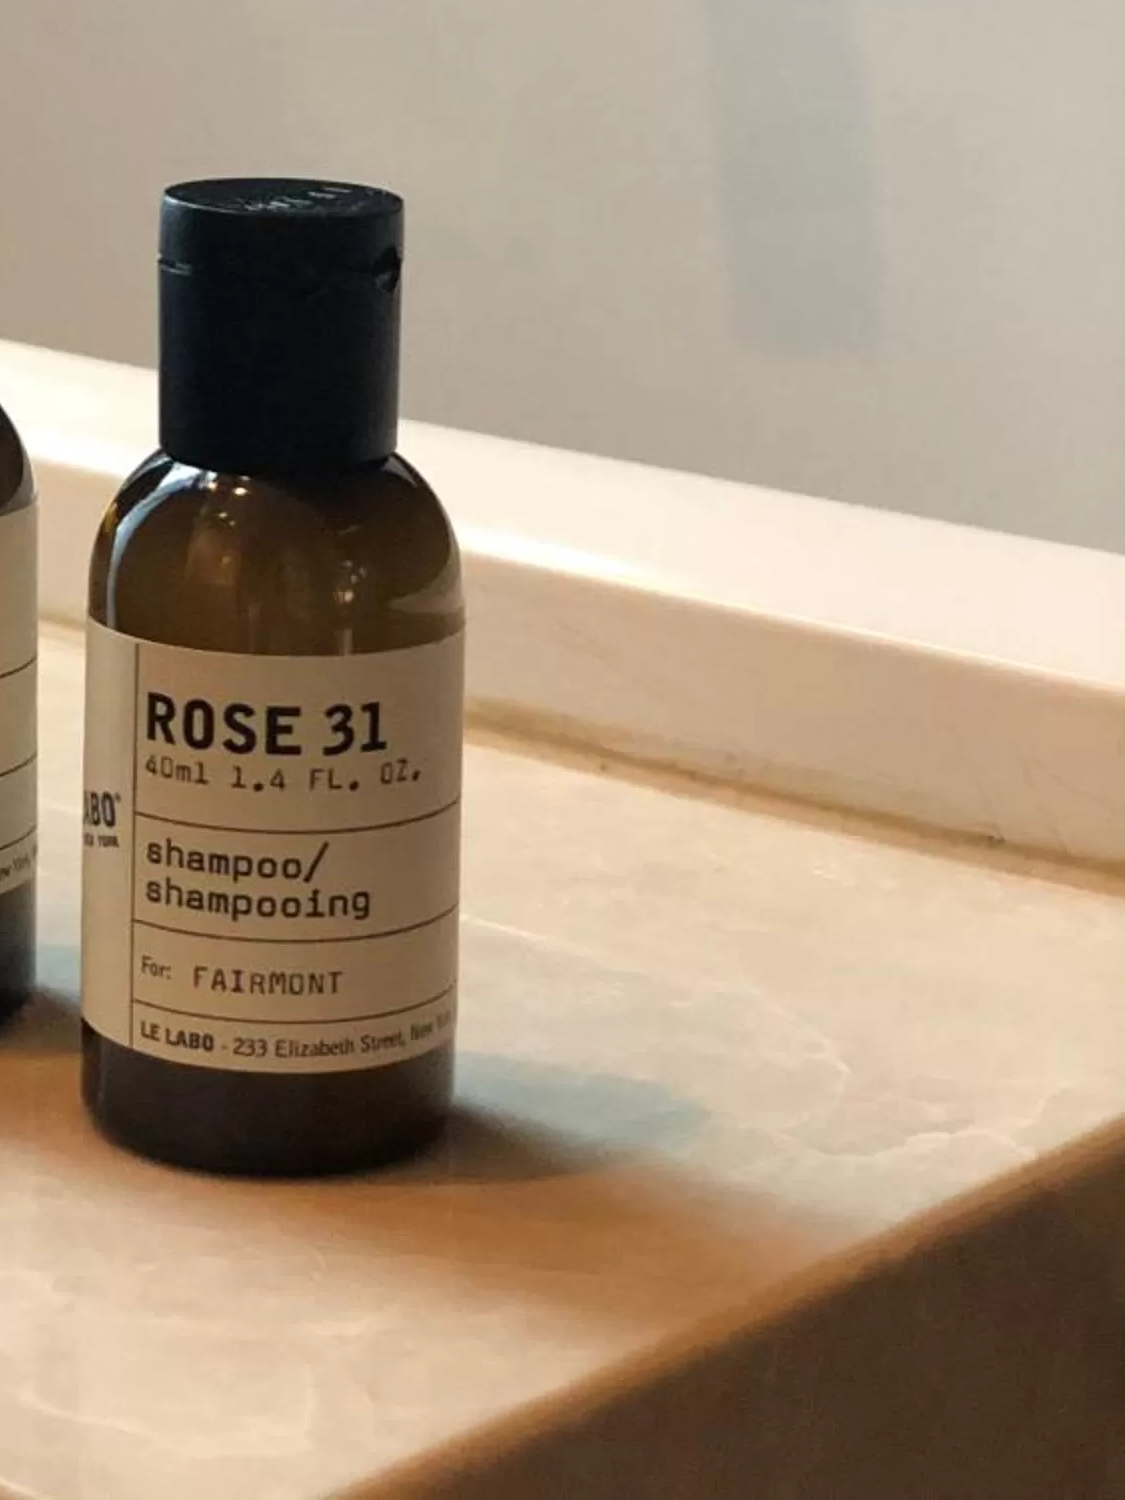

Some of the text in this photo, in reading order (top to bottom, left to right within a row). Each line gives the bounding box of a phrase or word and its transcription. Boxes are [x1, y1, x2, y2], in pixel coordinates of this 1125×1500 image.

[146, 691, 387, 755] ROSE 31
[145, 757, 421, 792] 40ml 1.4 FL. OZ.
[146, 837, 330, 884] shampoo/
[145, 877, 371, 921] shampooing
[141, 955, 344, 995] For: FAIRMONT
[140, 1020, 159, 1042] LE
[165, 1027, 214, 1052] LABO
[233, 1037, 268, 1057] 233
[275, 1036, 355, 1058] Elizabeth
[360, 1028, 406, 1053] Street,
